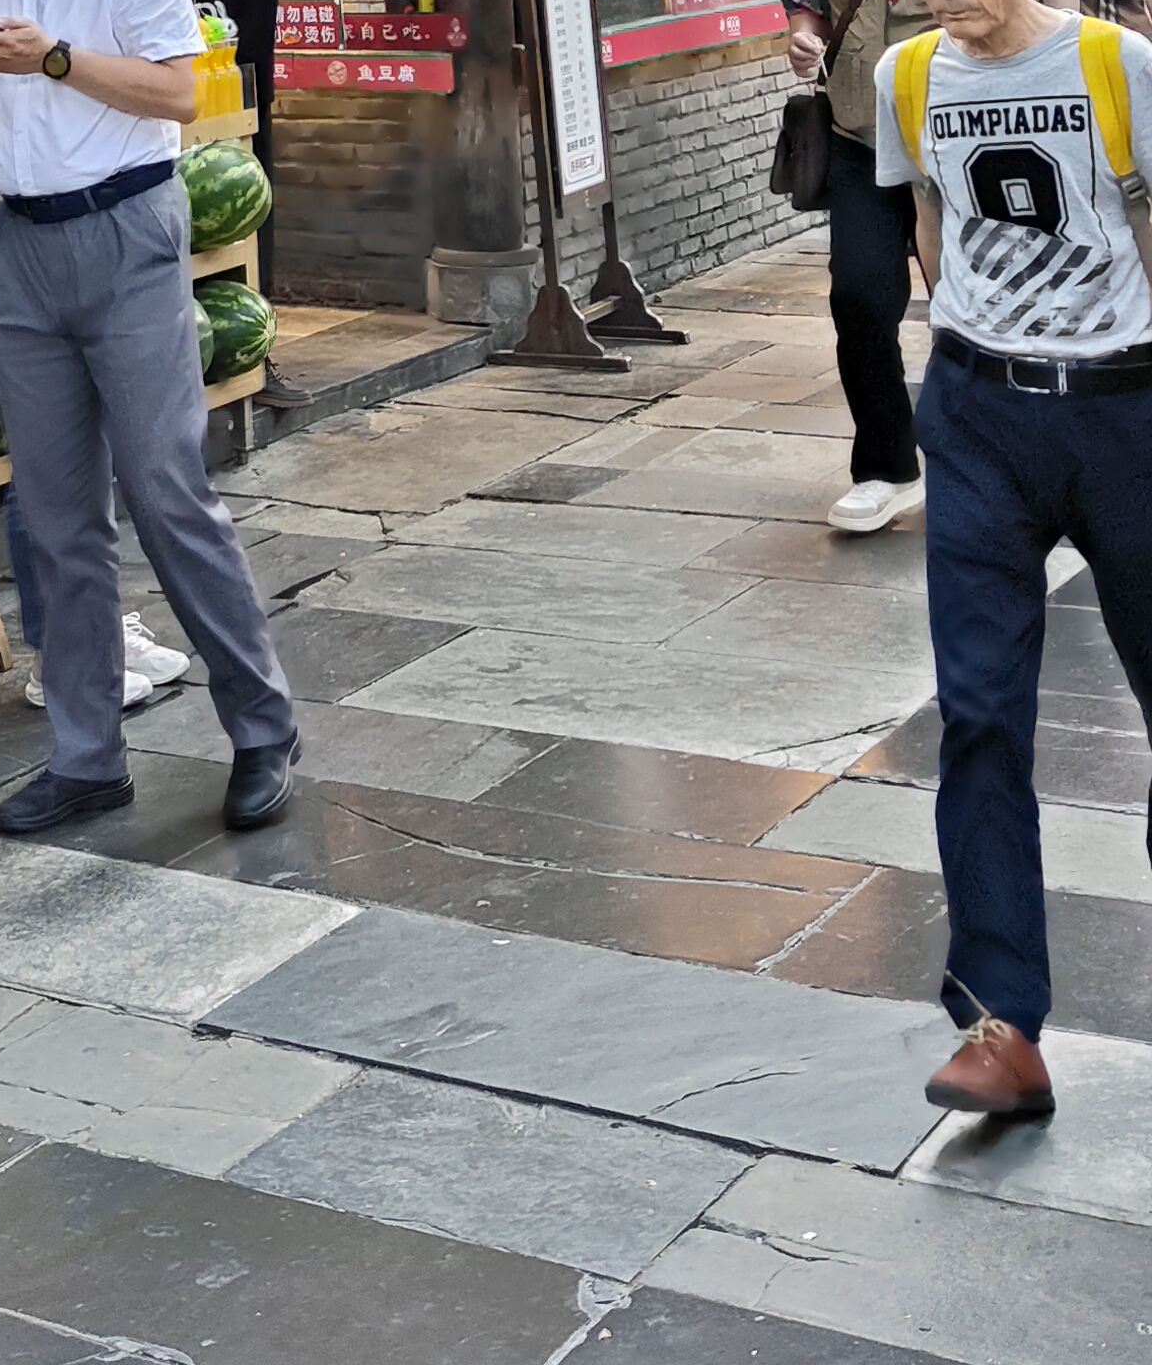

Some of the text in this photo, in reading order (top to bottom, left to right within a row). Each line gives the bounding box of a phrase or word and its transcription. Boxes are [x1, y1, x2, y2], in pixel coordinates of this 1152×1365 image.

[357, 64, 415, 82] 鱼豆腐
[933, 103, 1086, 139] OLIMPIADAS
